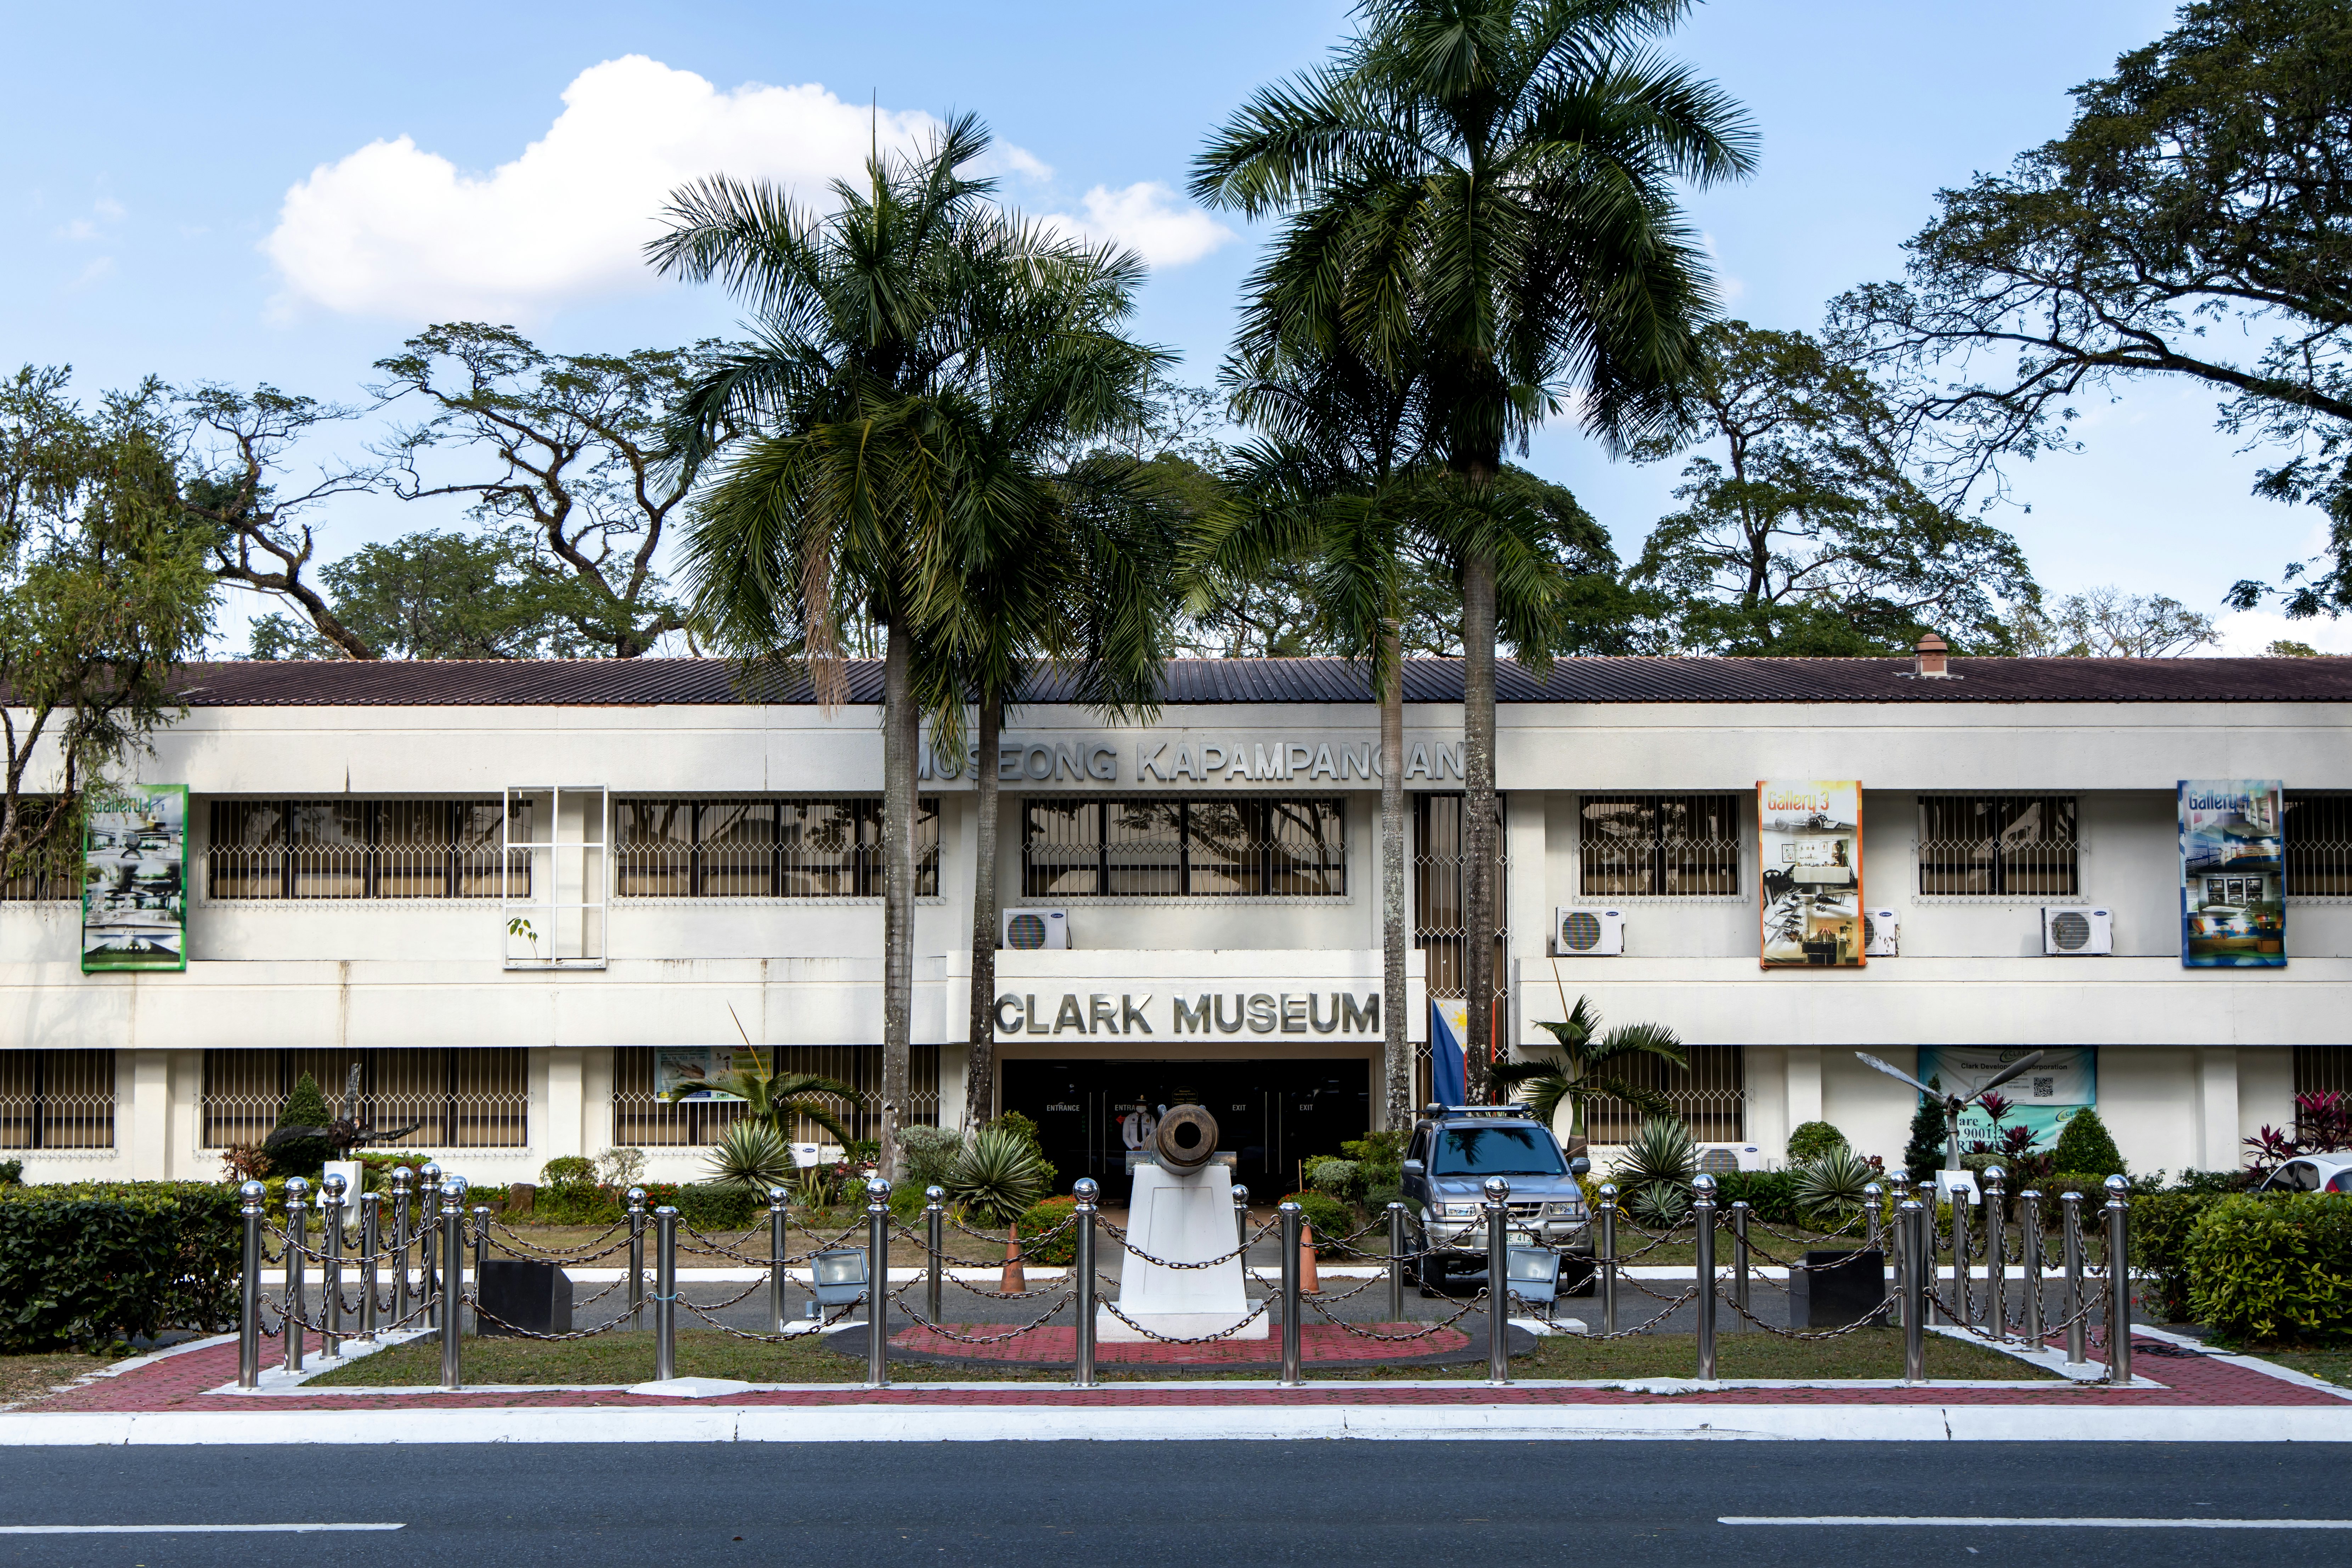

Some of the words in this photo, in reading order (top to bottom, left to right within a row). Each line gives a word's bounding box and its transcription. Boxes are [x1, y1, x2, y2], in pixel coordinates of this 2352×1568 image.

[1768, 790, 1816, 814] Gallery
[1821, 790, 1829, 811] 3
[2189, 789, 2237, 813] Gallery
[2241, 789, 2250, 809] 4
[994, 993, 1153, 1033] CLARK
[1173, 993, 1380, 1033] MUSEUM
[1959, 1118, 1978, 1126] are
